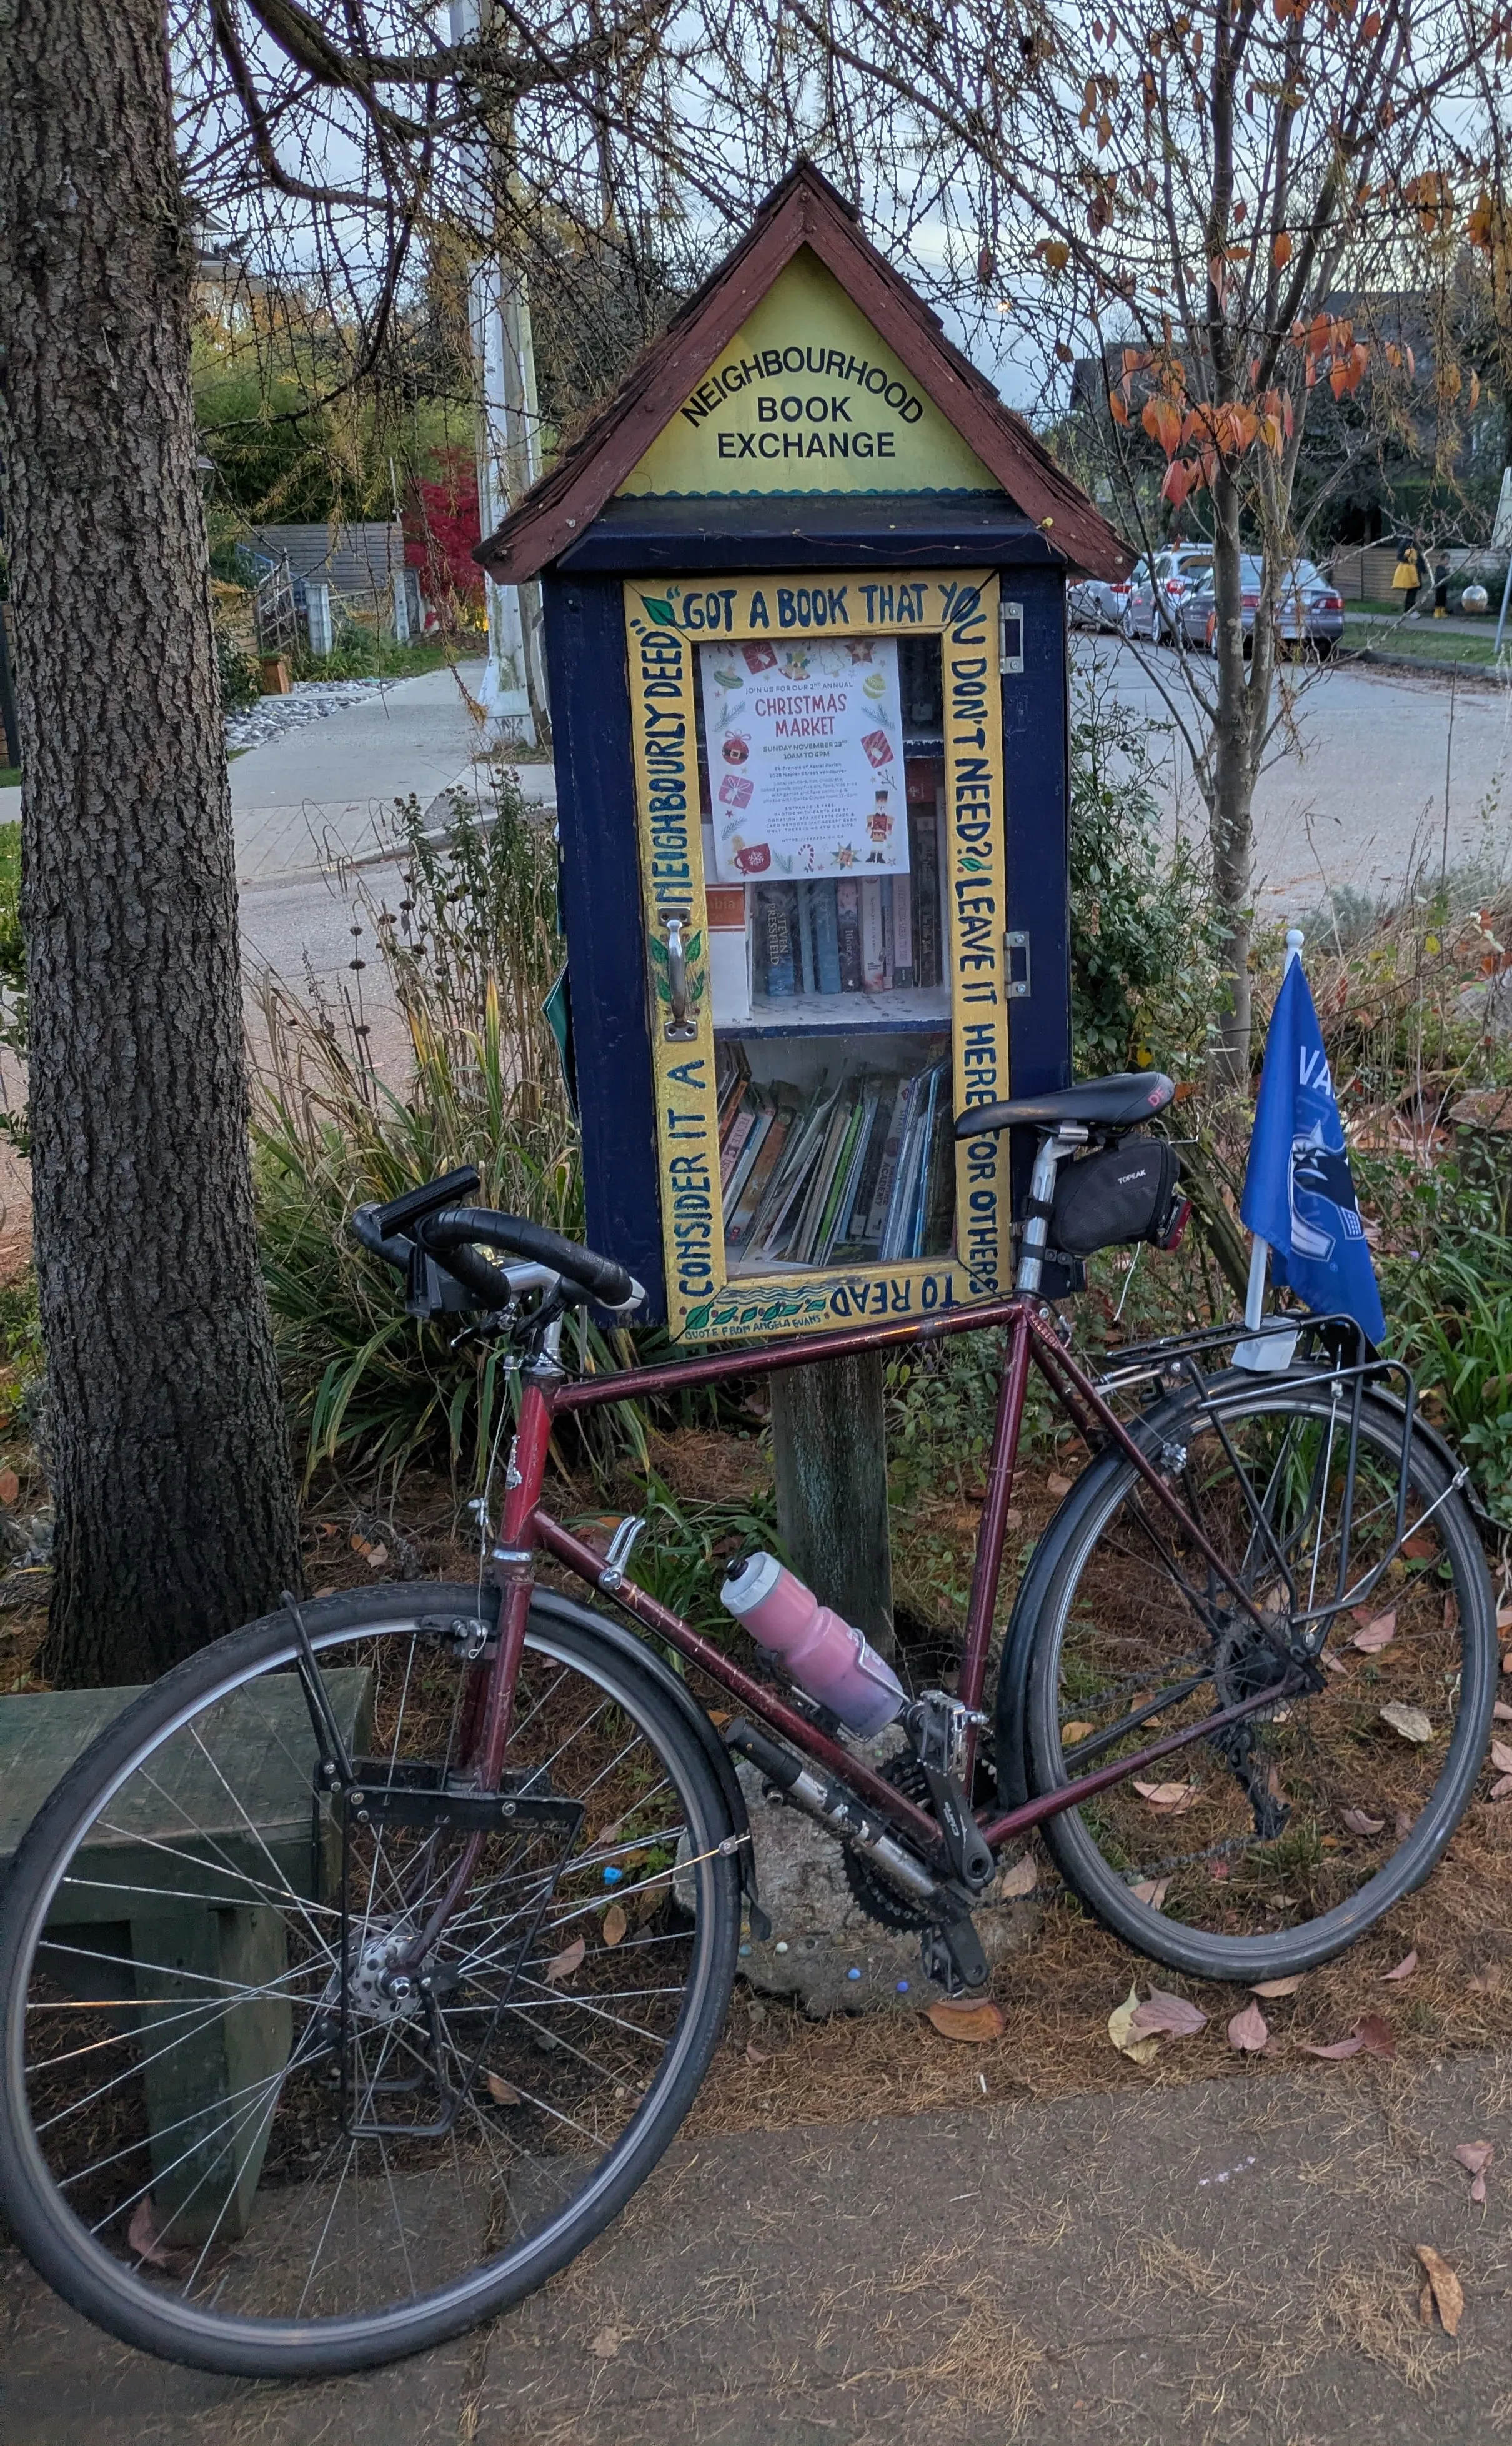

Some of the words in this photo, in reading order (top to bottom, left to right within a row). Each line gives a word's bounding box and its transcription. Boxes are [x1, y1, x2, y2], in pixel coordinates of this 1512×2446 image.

[680, 346, 923, 429] NEIGHBOURHOOD
[757, 396, 853, 422] BOOK
[717, 432, 895, 459] EXCHANGE
[750, 590, 770, 629] A
[778, 587, 848, 627] BOOK
[859, 583, 928, 624] THAT
[938, 582, 987, 644] YOU
[755, 694, 847, 717] CHRISTMAS
[951, 657, 987, 750] DON'T
[775, 716, 835, 737] MARKET
[763, 744, 792, 752] SUNDAY
[793, 742, 833, 750] NOVEMBER
[644, 703, 694, 903] NEIGHBOURLY
[767, 903, 779, 965] PRESSFIELD
[778, 912, 788, 954] STEVEN
[955, 877, 997, 973] LEAVE
[962, 982, 998, 1005] IT
[667, 1059, 705, 1090] A
[1298, 1045, 1336, 1099] VA
[667, 1108, 706, 1140] IT
[967, 1130, 1000, 1184] OR
[1117, 1169, 1146, 1185] TOPEAK
[875, 1163, 891, 1206] ACADEMY
[668, 1151, 714, 1298] CONSIDER
[968, 1190, 1000, 1295] OTHERS
[830, 1278, 910, 1317] READ
[921, 1274, 961, 1310] TO
[685, 1326, 717, 1340] QUOTE
[722, 1323, 751, 1336] FROM
[753, 1318, 791, 1333] ANGELA
[793, 1315, 822, 1328] EVANS
